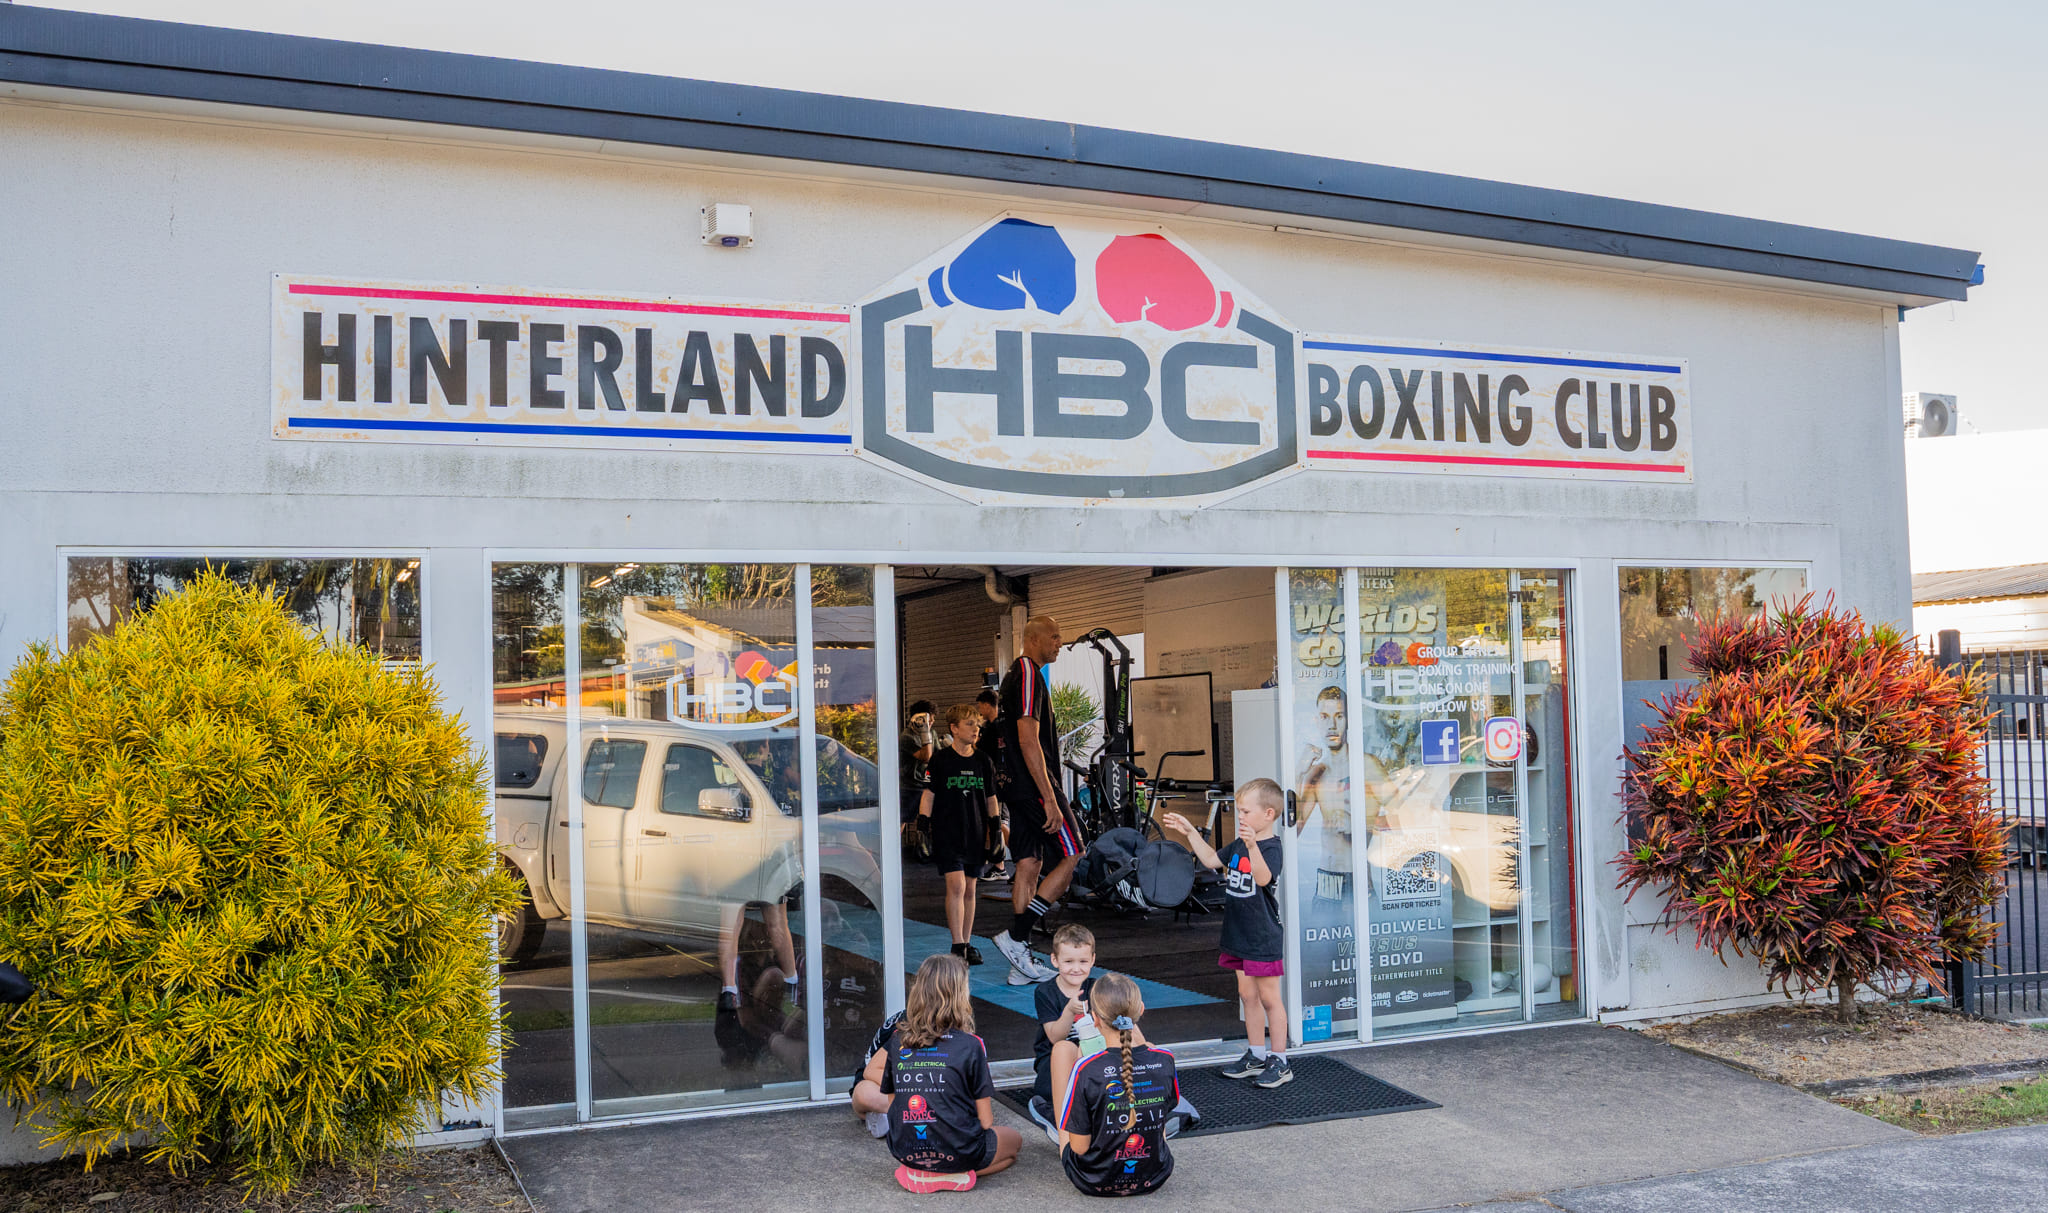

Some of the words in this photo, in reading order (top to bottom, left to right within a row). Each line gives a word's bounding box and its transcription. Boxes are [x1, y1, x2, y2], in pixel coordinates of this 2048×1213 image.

[302, 311, 847, 418] HINTERLAND
[904, 324, 1261, 446] HBC
[1307, 363, 1533, 447] BOXING
[1554, 377, 1677, 452] CLUB
[1417, 646, 1458, 658] GROUP
[1418, 664, 1462, 677] BOXING
[1465, 662, 1519, 676] TRAINING
[1419, 682, 1445, 695] ONE
[1445, 682, 1462, 694] ON
[1465, 681, 1489, 693] ONE
[678, 682, 787, 714] HBC
[1420, 700, 1467, 713] FOLLOW
[1471, 699, 1487, 711] US
[1382, 903, 1400, 911] SCAN
[1415, 900, 1441, 908] TICKETS
[1306, 925, 1353, 942] DANA
[1369, 917, 1446, 936] OOLWELL
[1380, 951, 1423, 967] BOYD
[1309, 980, 1322, 988] IBF
[1325, 978, 1338, 986] PAN
[1371, 969, 1423, 982] EATHERWEIGHT
[1426, 967, 1443, 976] TITLE
[1134, 1096, 1165, 1106] LECTRICAL
[903, 1110, 936, 1121] BMEC
